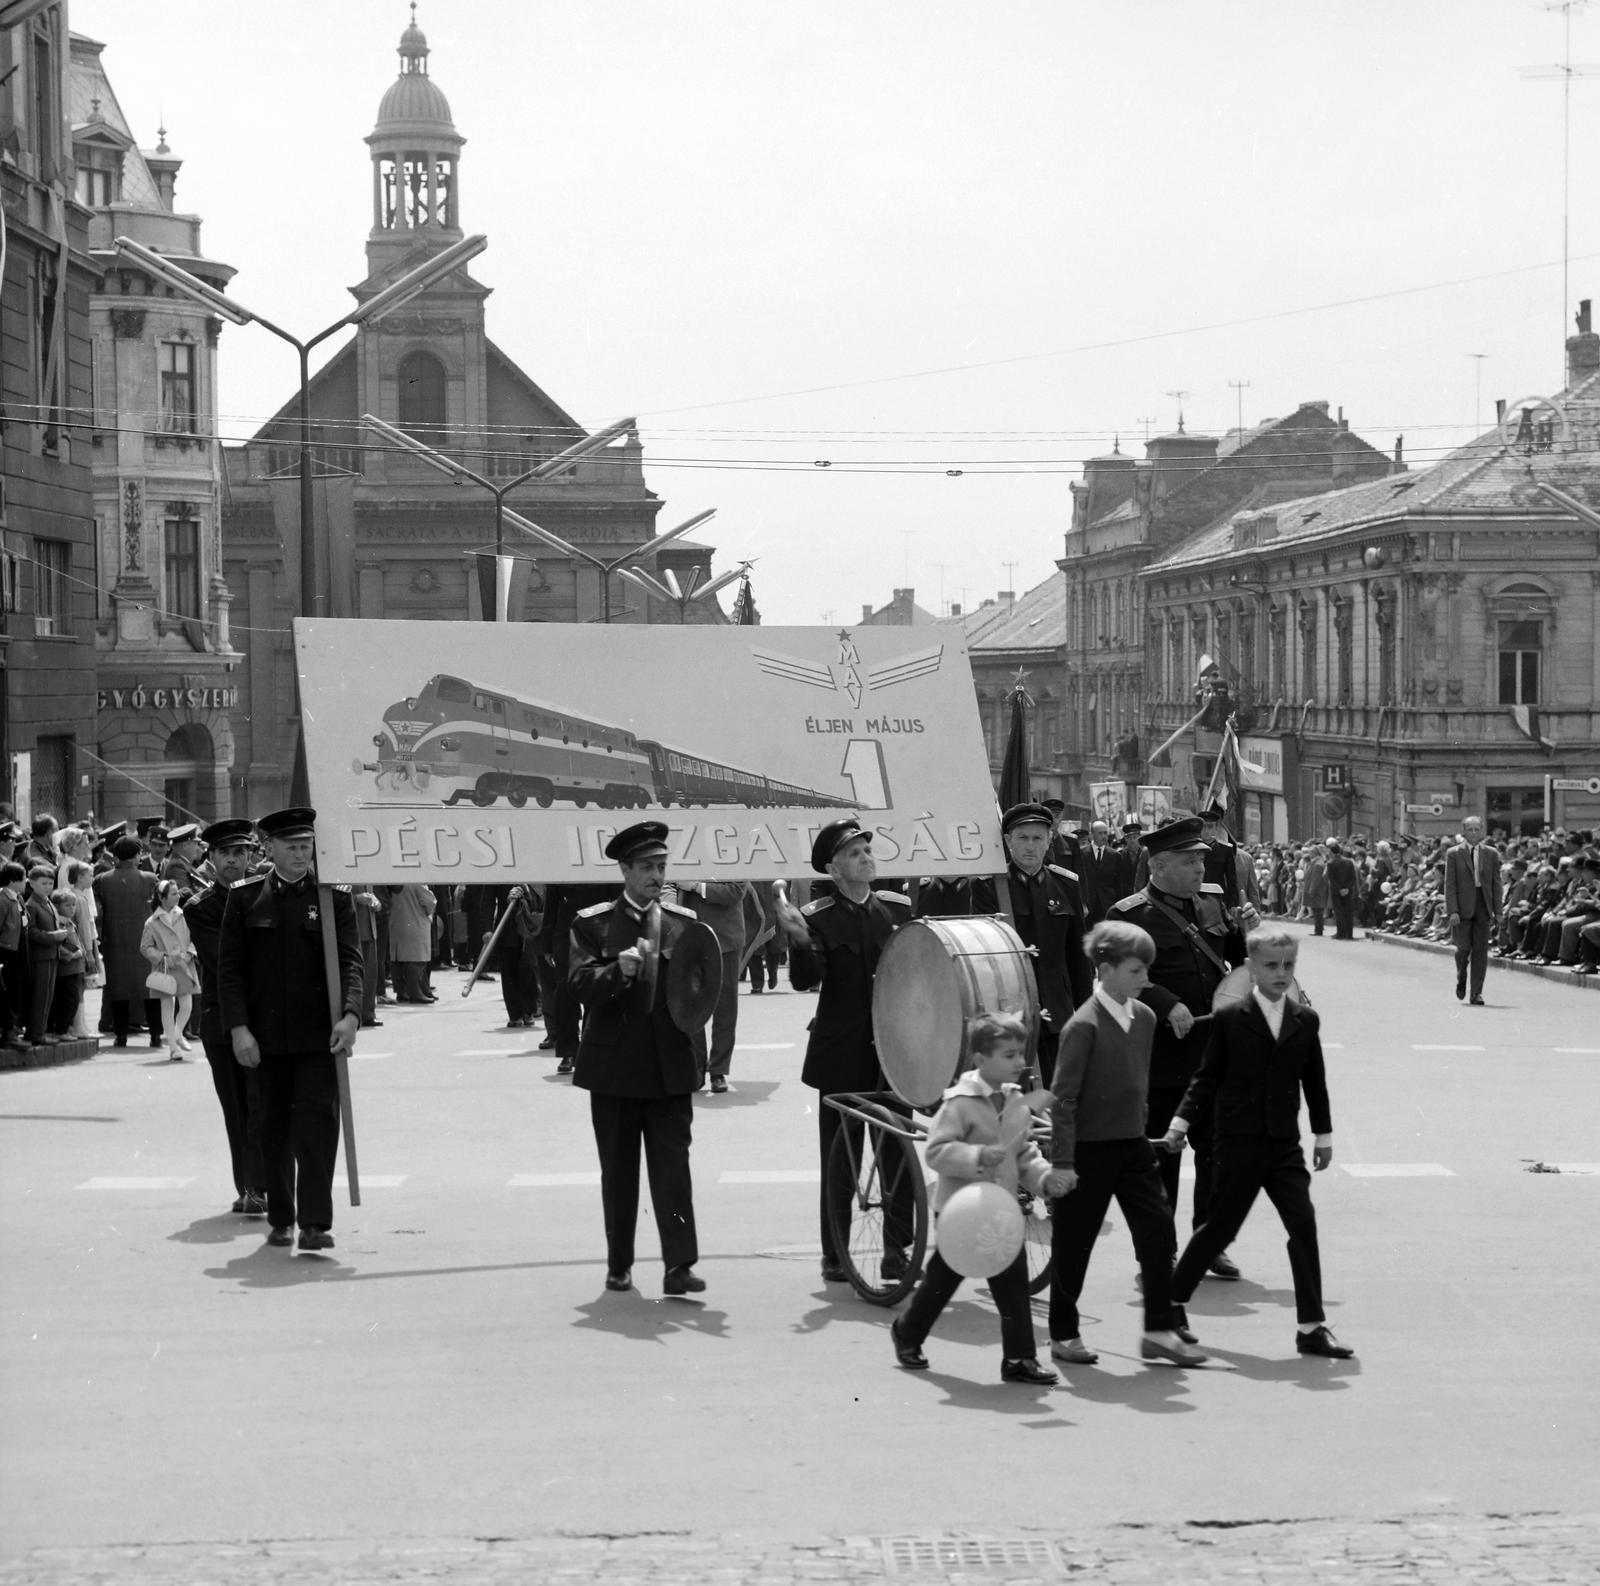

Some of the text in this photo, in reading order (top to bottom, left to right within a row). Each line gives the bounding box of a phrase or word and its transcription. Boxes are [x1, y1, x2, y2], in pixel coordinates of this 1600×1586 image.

[805, 715, 925, 733] ÉLJEN MÁJUS
[840, 738, 894, 811] 1
[1327, 767, 1341, 783] H
[342, 810, 984, 868] PÉCSI IGZGATSÁG
